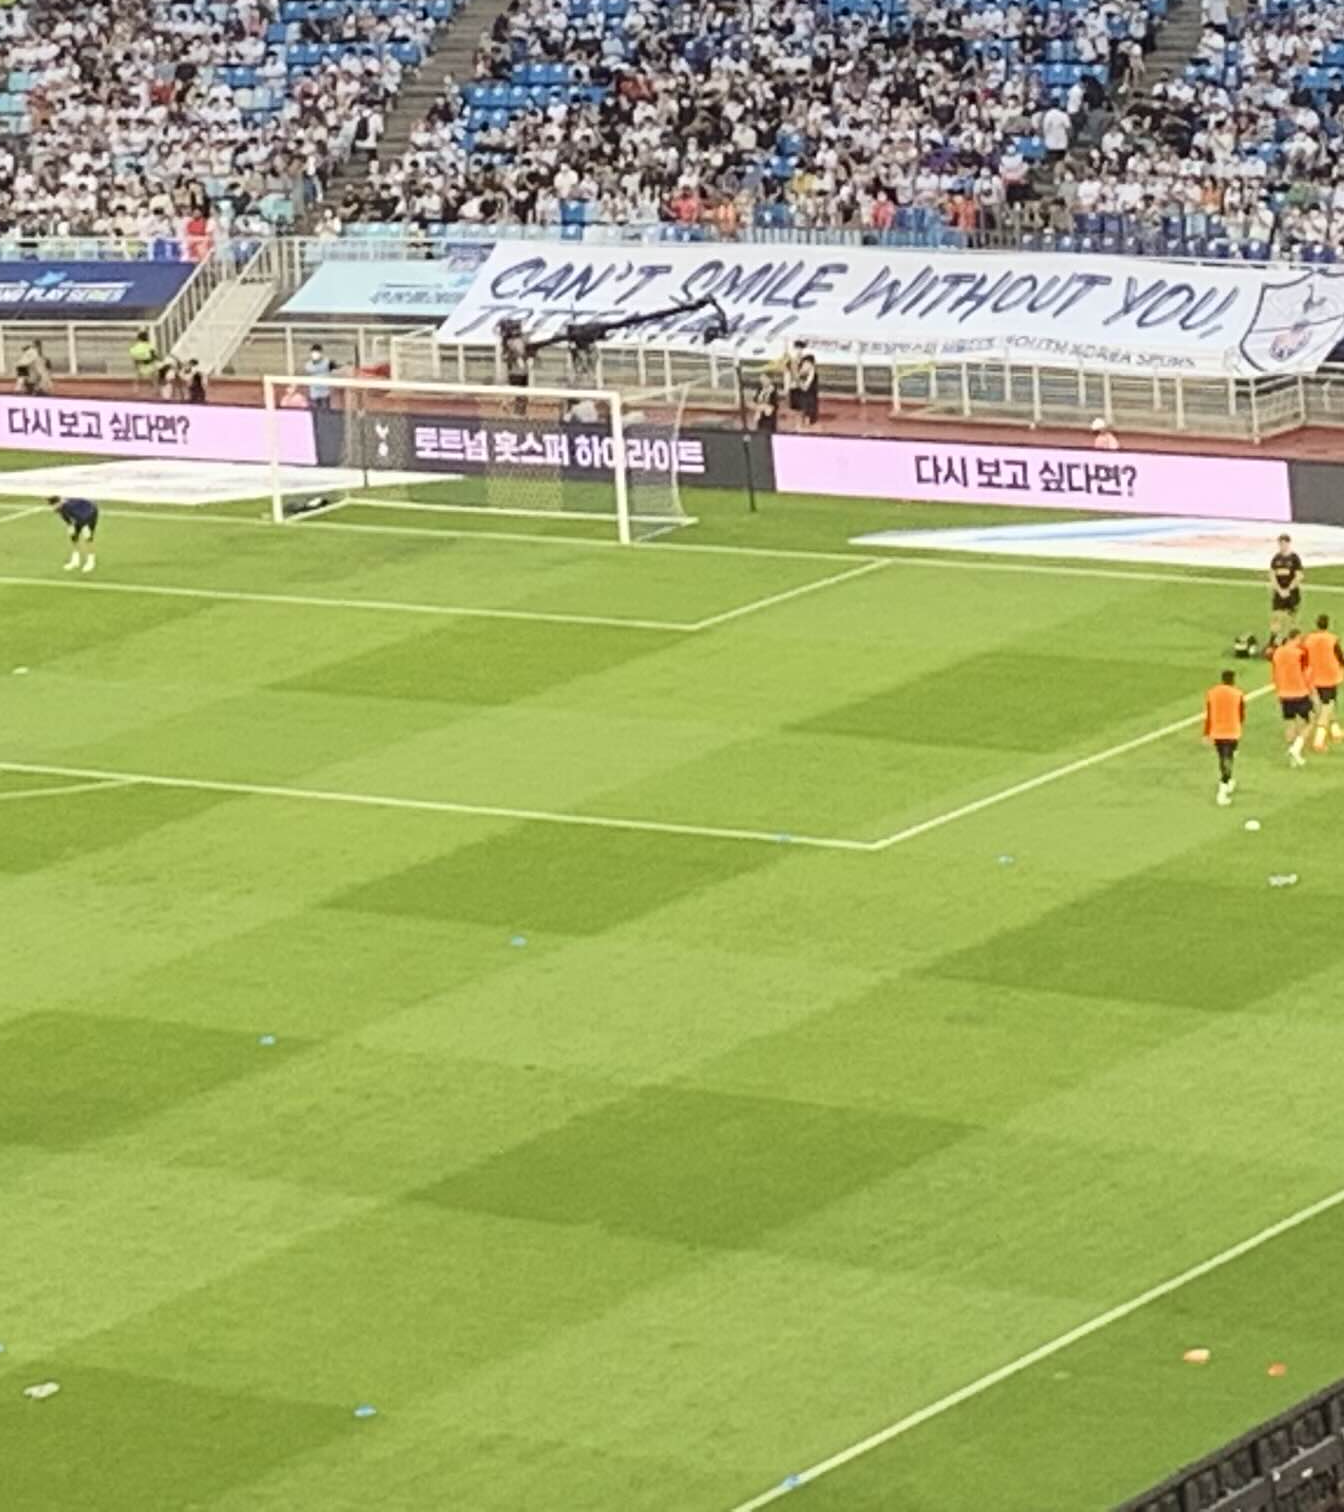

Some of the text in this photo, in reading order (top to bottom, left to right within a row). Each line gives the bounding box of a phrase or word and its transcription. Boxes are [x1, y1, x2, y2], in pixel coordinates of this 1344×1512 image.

[490, 256, 673, 306] CAN'T
[670, 259, 848, 309] SMILE
[844, 265, 1112, 322] WITHOUT
[7, 406, 191, 445] 다시 보고 싶다면?
[414, 426, 490, 463] 토트넘
[577, 434, 706, 474] 하이라이트
[914, 454, 1138, 496] 다시 보고 싶다면?
